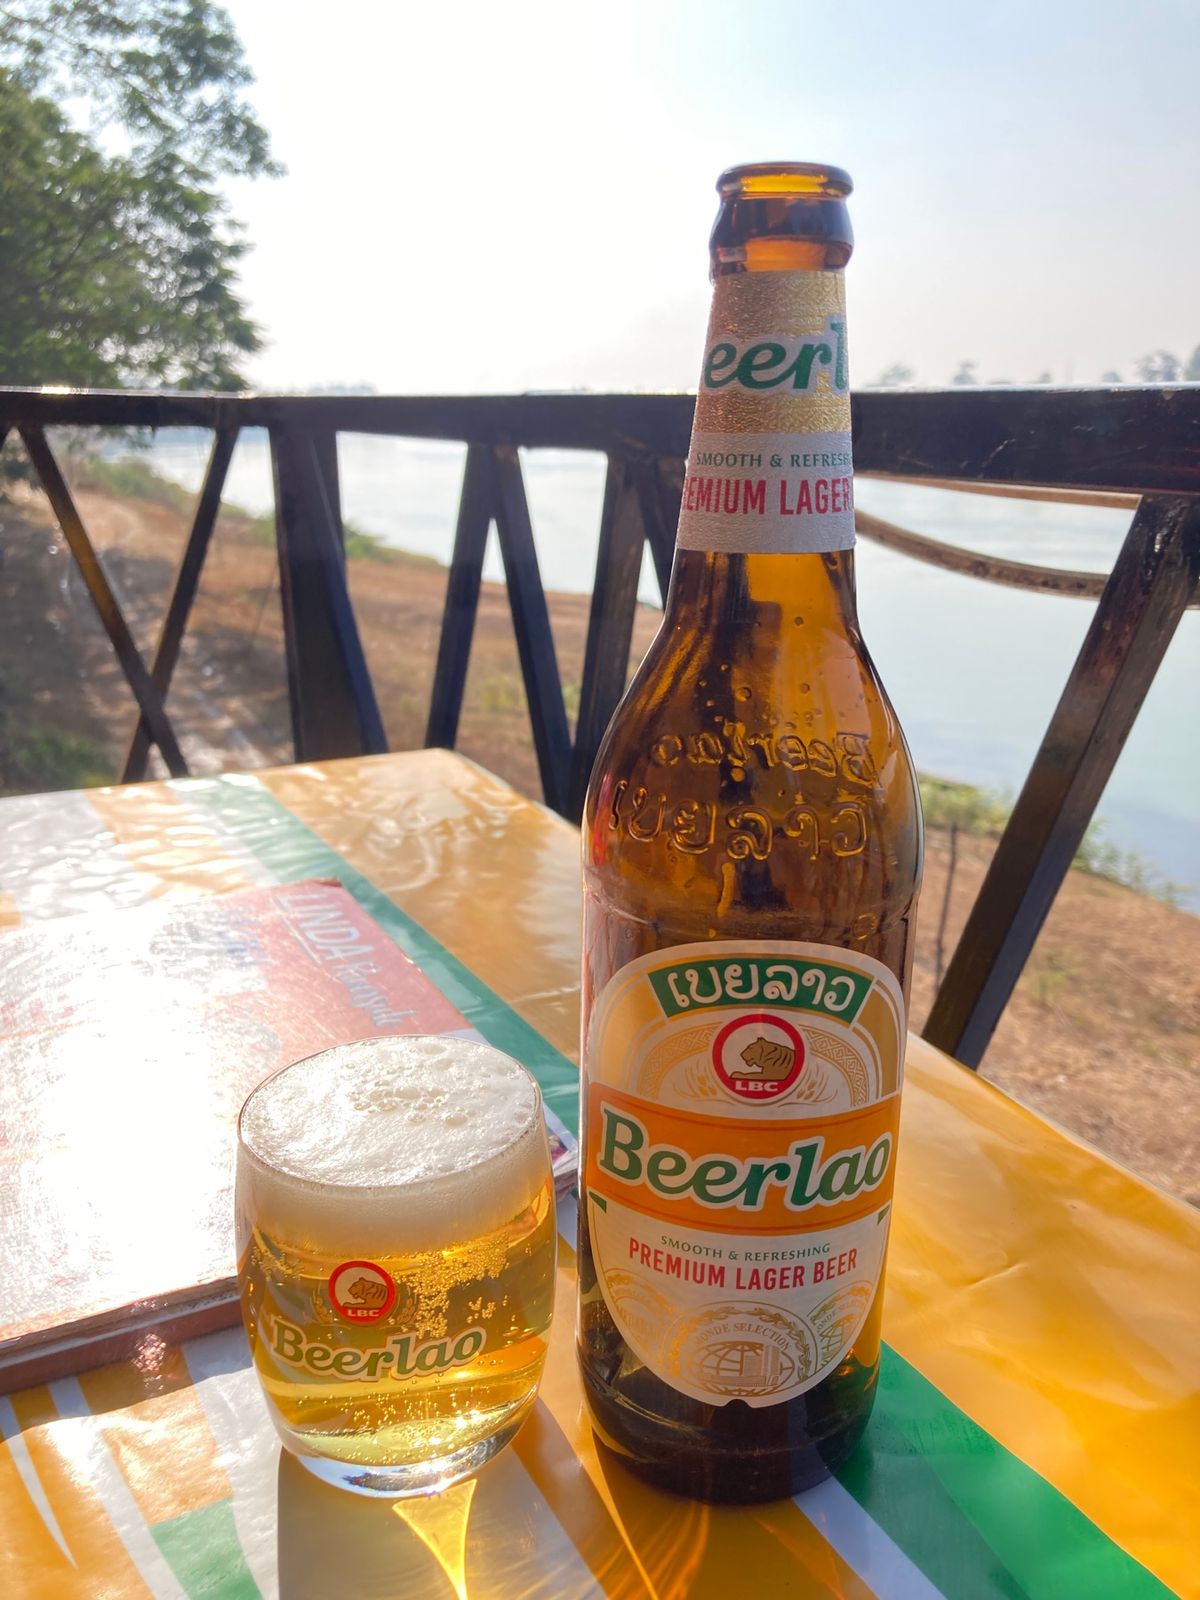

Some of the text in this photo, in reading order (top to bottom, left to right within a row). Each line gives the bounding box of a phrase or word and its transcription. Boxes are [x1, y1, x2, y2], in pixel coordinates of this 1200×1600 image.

[696, 452, 762, 467] SMOOTH
[769, 453, 783, 467] &
[684, 477, 850, 515] EMIUM LAGER
[275, 892, 375, 961] LINDA
[667, 963, 856, 1012] ເບຍລາວ
[734, 1079, 779, 1092] LBC
[598, 1105, 891, 1208] Beerlao
[628, 1237, 858, 1291] PREMIUM LAGER BEER
[661, 1235, 831, 1262] SMOOTH & REFRESHING
[346, 1308, 380, 1318] LBC
[271, 1318, 484, 1379] Beerlao
